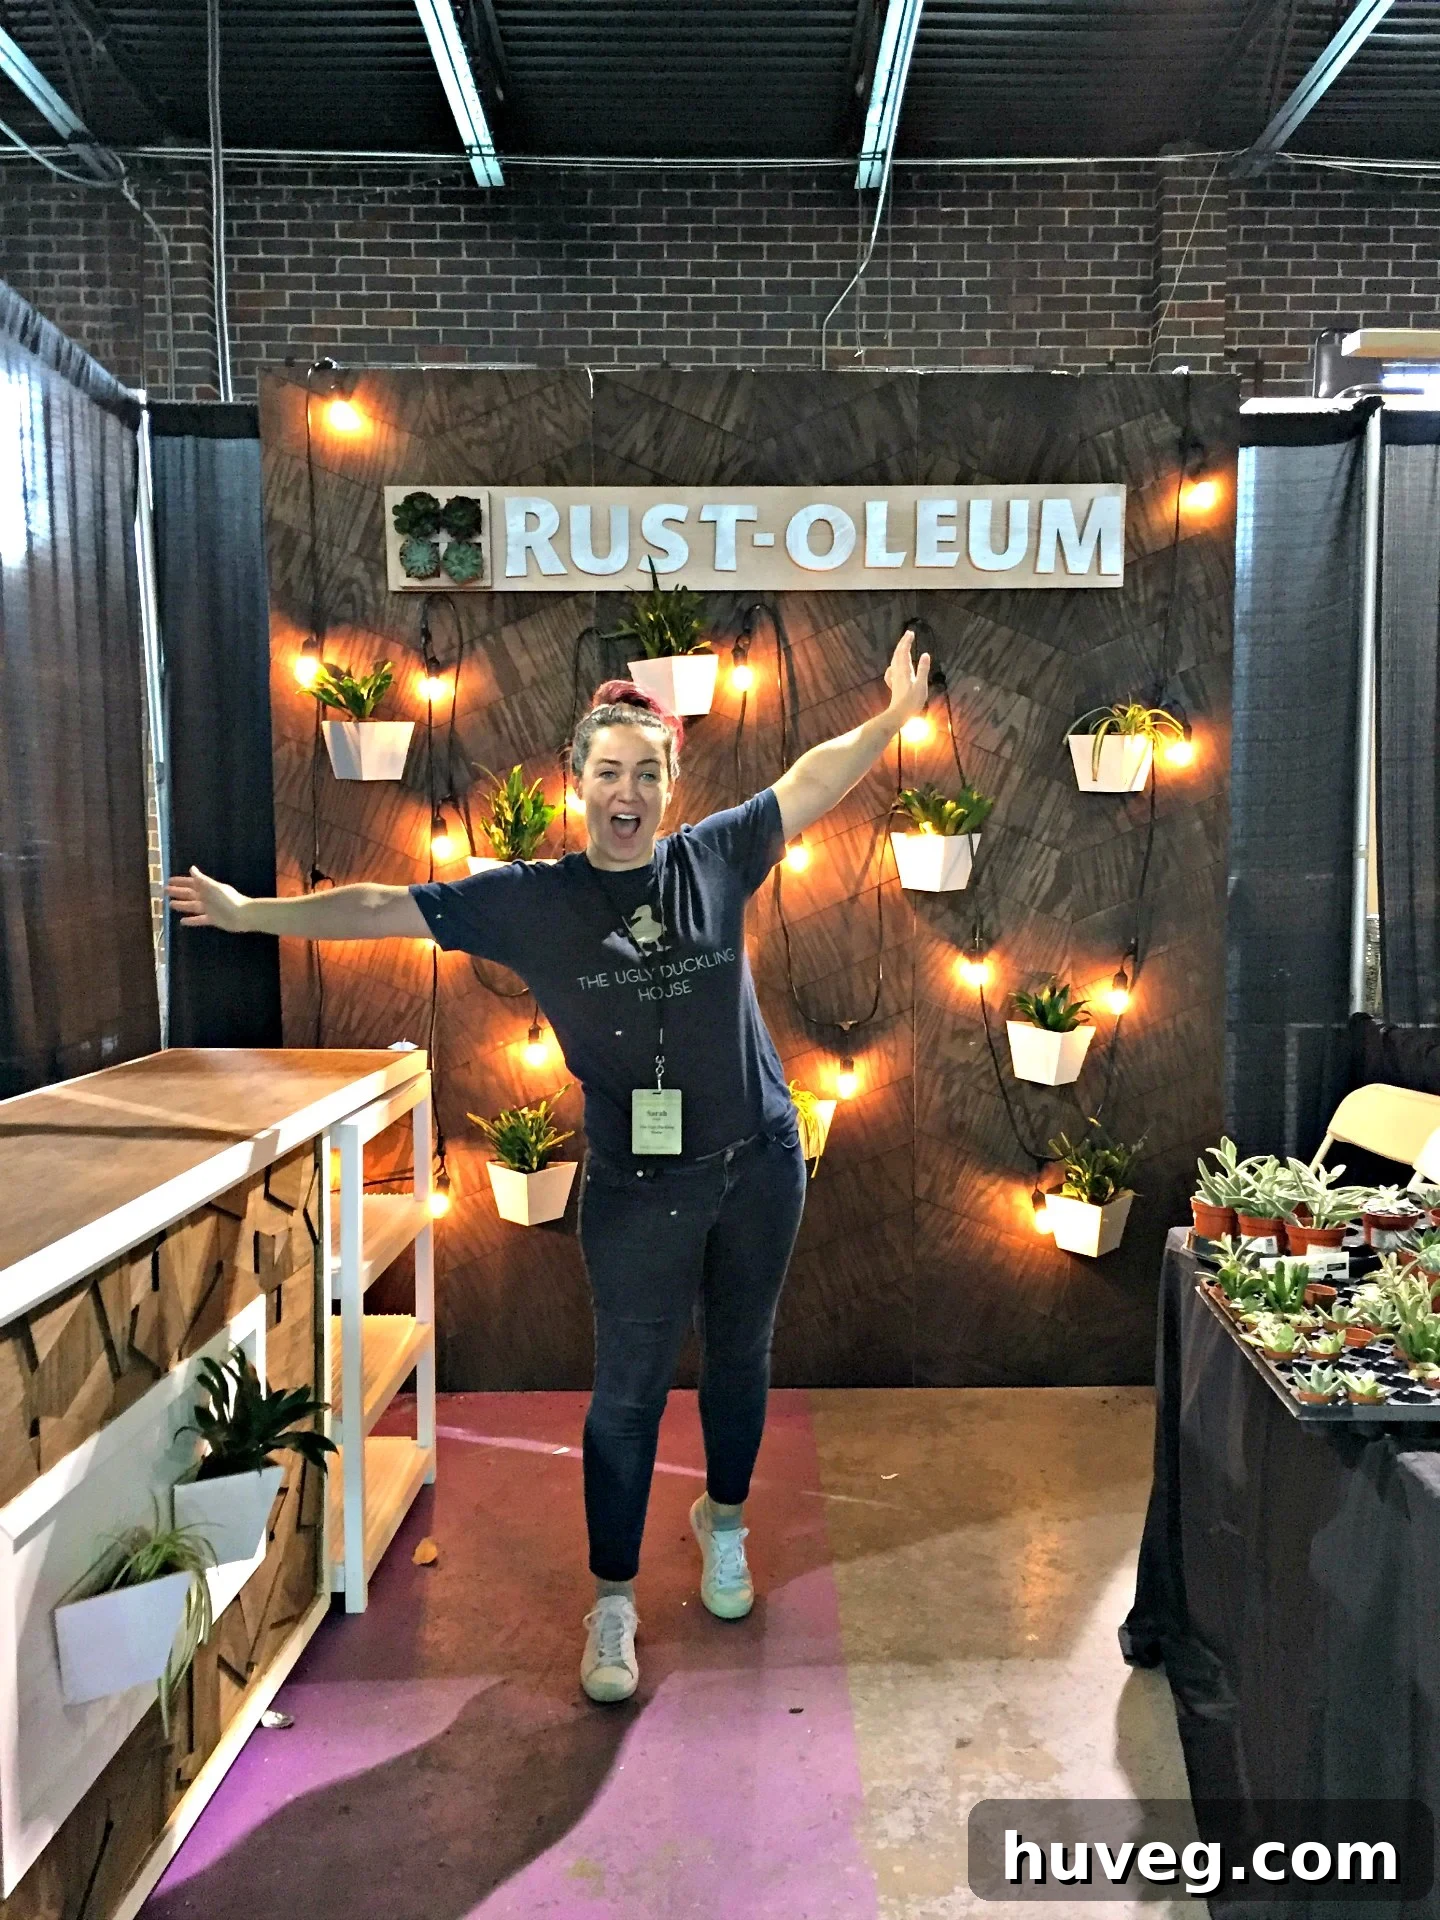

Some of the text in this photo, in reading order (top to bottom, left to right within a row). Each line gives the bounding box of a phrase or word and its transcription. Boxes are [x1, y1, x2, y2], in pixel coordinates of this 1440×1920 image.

[504, 495, 1122, 577] RUST-OLEUM
[577, 948, 736, 991] THE UGLY DUCKLING
